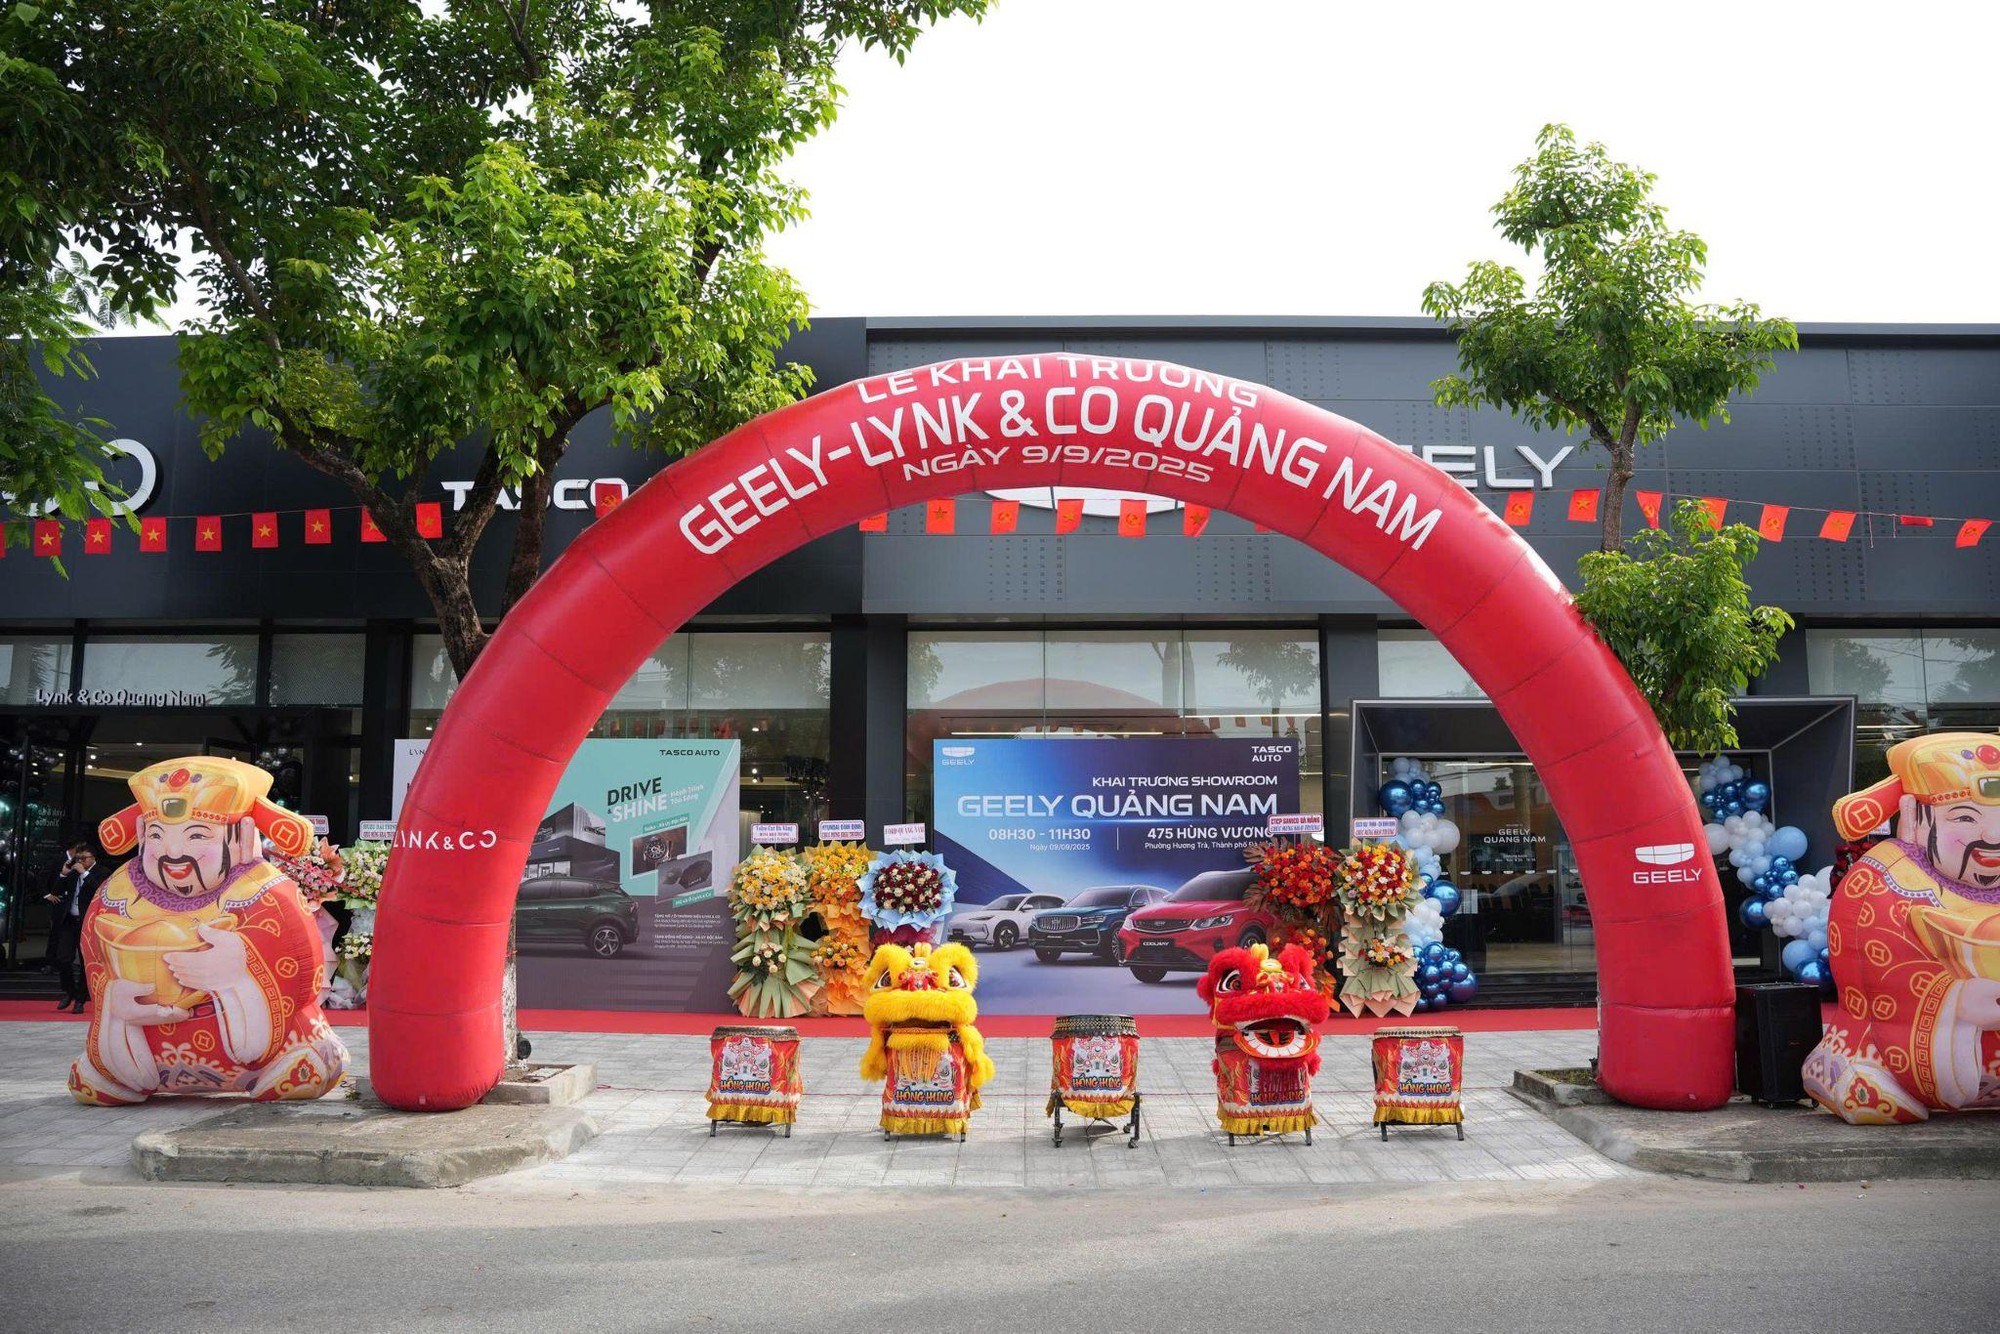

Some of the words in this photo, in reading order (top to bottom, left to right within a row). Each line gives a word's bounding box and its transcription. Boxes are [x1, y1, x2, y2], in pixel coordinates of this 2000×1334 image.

[930, 357, 1042, 387] KHAI
[903, 444, 1010, 481] NGÀY
[1022, 444, 1214, 483] 9/9/2025
[1000, 389, 1039, 438] &
[1045, 386, 1118, 435] CO
[1134, 394, 1328, 489] QUẢNG
[1322, 455, 1442, 551] NAM
[35, 689, 73, 706] Lynk
[77, 689, 89, 703] &
[93, 690, 113, 704] Co
[170, 690, 206, 706] Nam
[1251, 745, 1292, 753] TASCO
[1251, 754, 1282, 762] AUTO
[1092, 776, 1126, 787] KHAI
[1128, 775, 1189, 787] TRƯƠNG
[1191, 775, 1278, 786] SHOWROOM
[607, 776, 662, 806] DRIVE
[611, 793, 668, 823] SHINE
[957, 795, 1064, 818] GEELY
[1071, 789, 1193, 819] QUẢNG
[1201, 794, 1277, 816] NAM
[988, 828, 1036, 840] 08H30
[1049, 828, 1091, 840] 11H30
[1147, 828, 1173, 839] 475
[1177, 825, 1217, 839] HÙNG
[1483, 836, 1521, 844] QUANG
[1523, 835, 1546, 843] NAM
[1498, 828, 1531, 836] GEELY
[1633, 868, 1703, 884] GEELY
